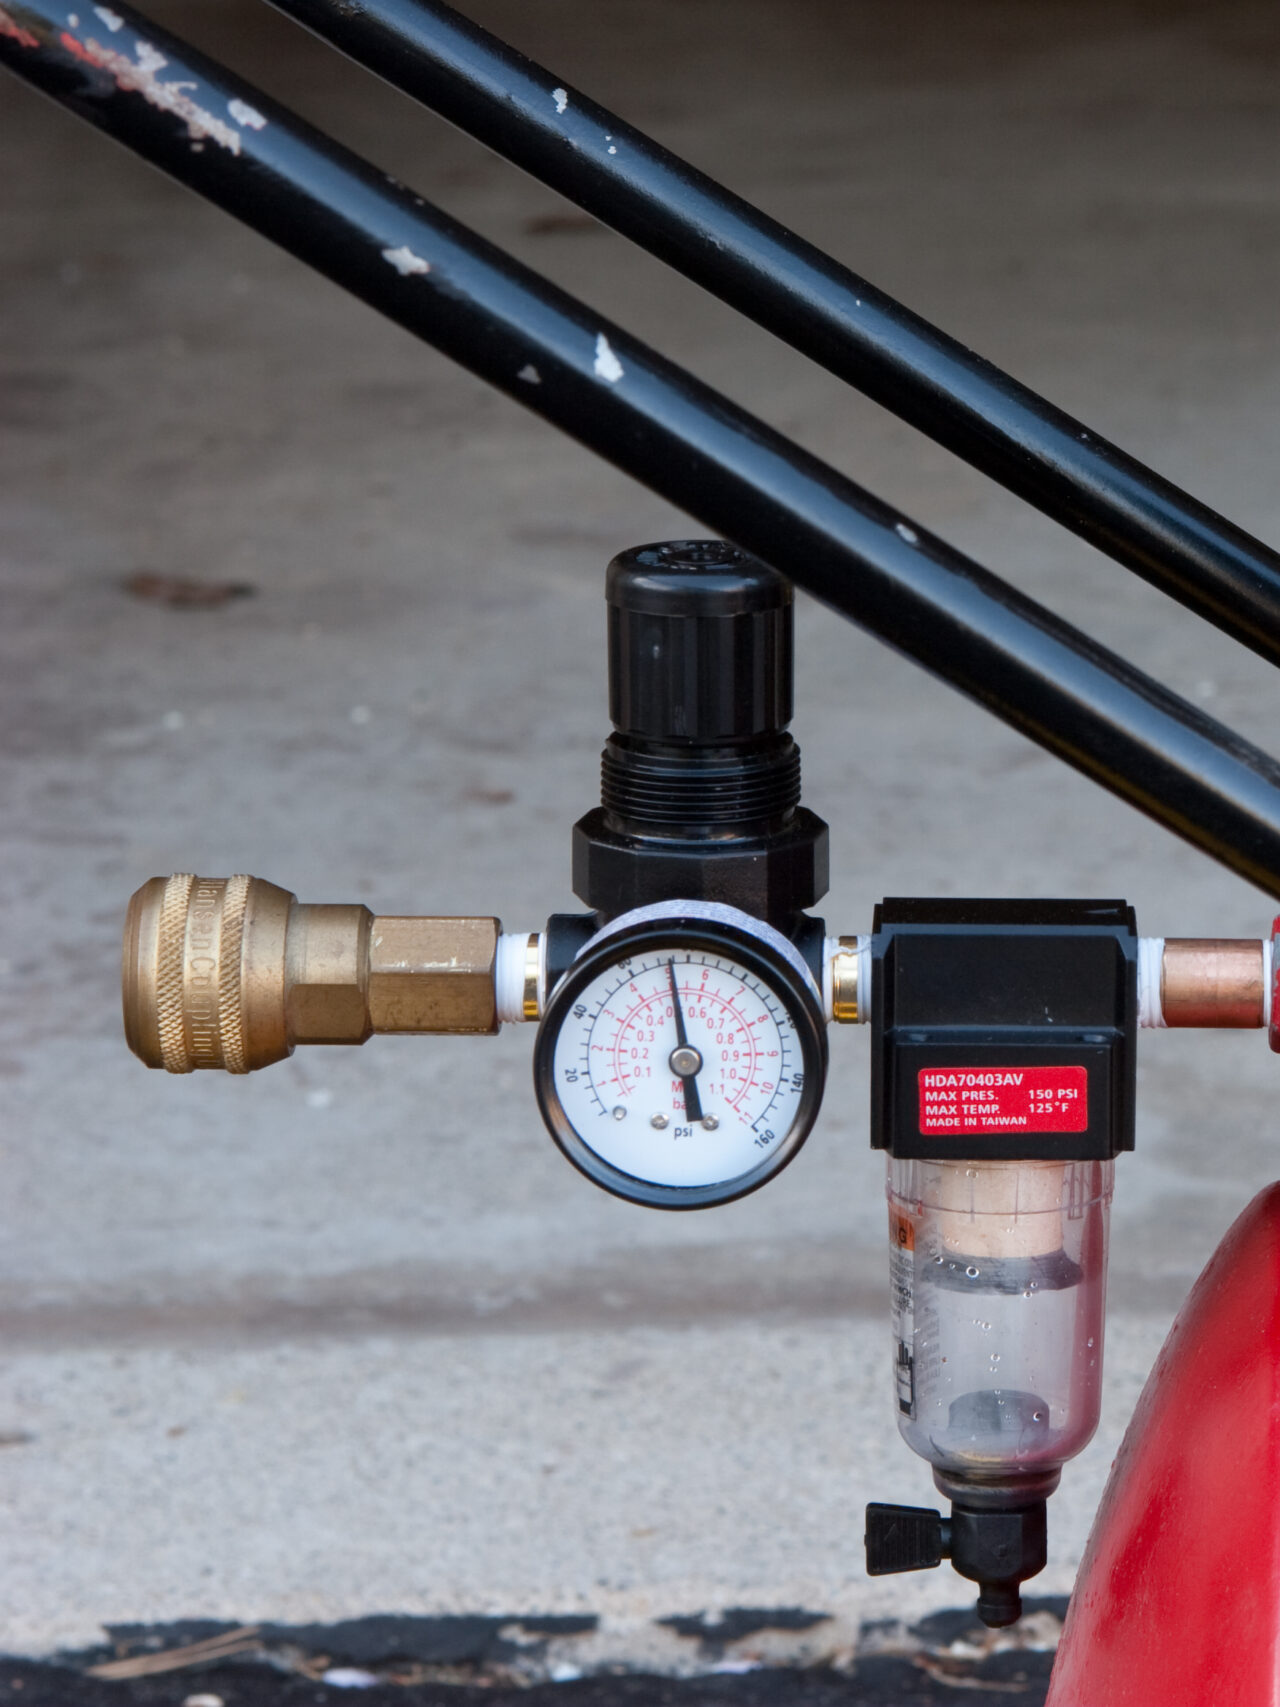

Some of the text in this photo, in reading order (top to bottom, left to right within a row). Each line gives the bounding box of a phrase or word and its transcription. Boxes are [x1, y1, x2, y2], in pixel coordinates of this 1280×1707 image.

[702, 969, 709, 981] 6
[629, 983, 638, 993] 4
[737, 985, 746, 996] 7
[573, 1004, 588, 1020] 40
[603, 1009, 615, 1018] 3
[688, 1006, 706, 1018] 0.6
[647, 1015, 664, 1026] 0.4
[707, 1018, 725, 1029] 0.7
[758, 1014, 768, 1023] 8
[637, 1030, 655, 1042] 0.3
[716, 1033, 734, 1045] 0.8
[631, 1048, 648, 1059] 0.2
[722, 1050, 740, 1061] 0.9
[564, 1068, 578, 1082] 20
[634, 1067, 651, 1077] 0.1
[720, 1068, 737, 1080] 1.0
[924, 1073, 1023, 1088] HDA70403AV
[710, 1084, 725, 1095] 1.1
[760, 1081, 774, 1096] 10
[925, 1088, 1078, 1102] MAX PRES. 150 PSI
[926, 1105, 957, 1116] MAX
[962, 1104, 1000, 1115] TEMP.
[739, 1112, 753, 1126] 11
[926, 1116, 1027, 1127] MADE IN TAIWAN
[674, 1124, 693, 1141] psi
[754, 1129, 775, 1149] 160
